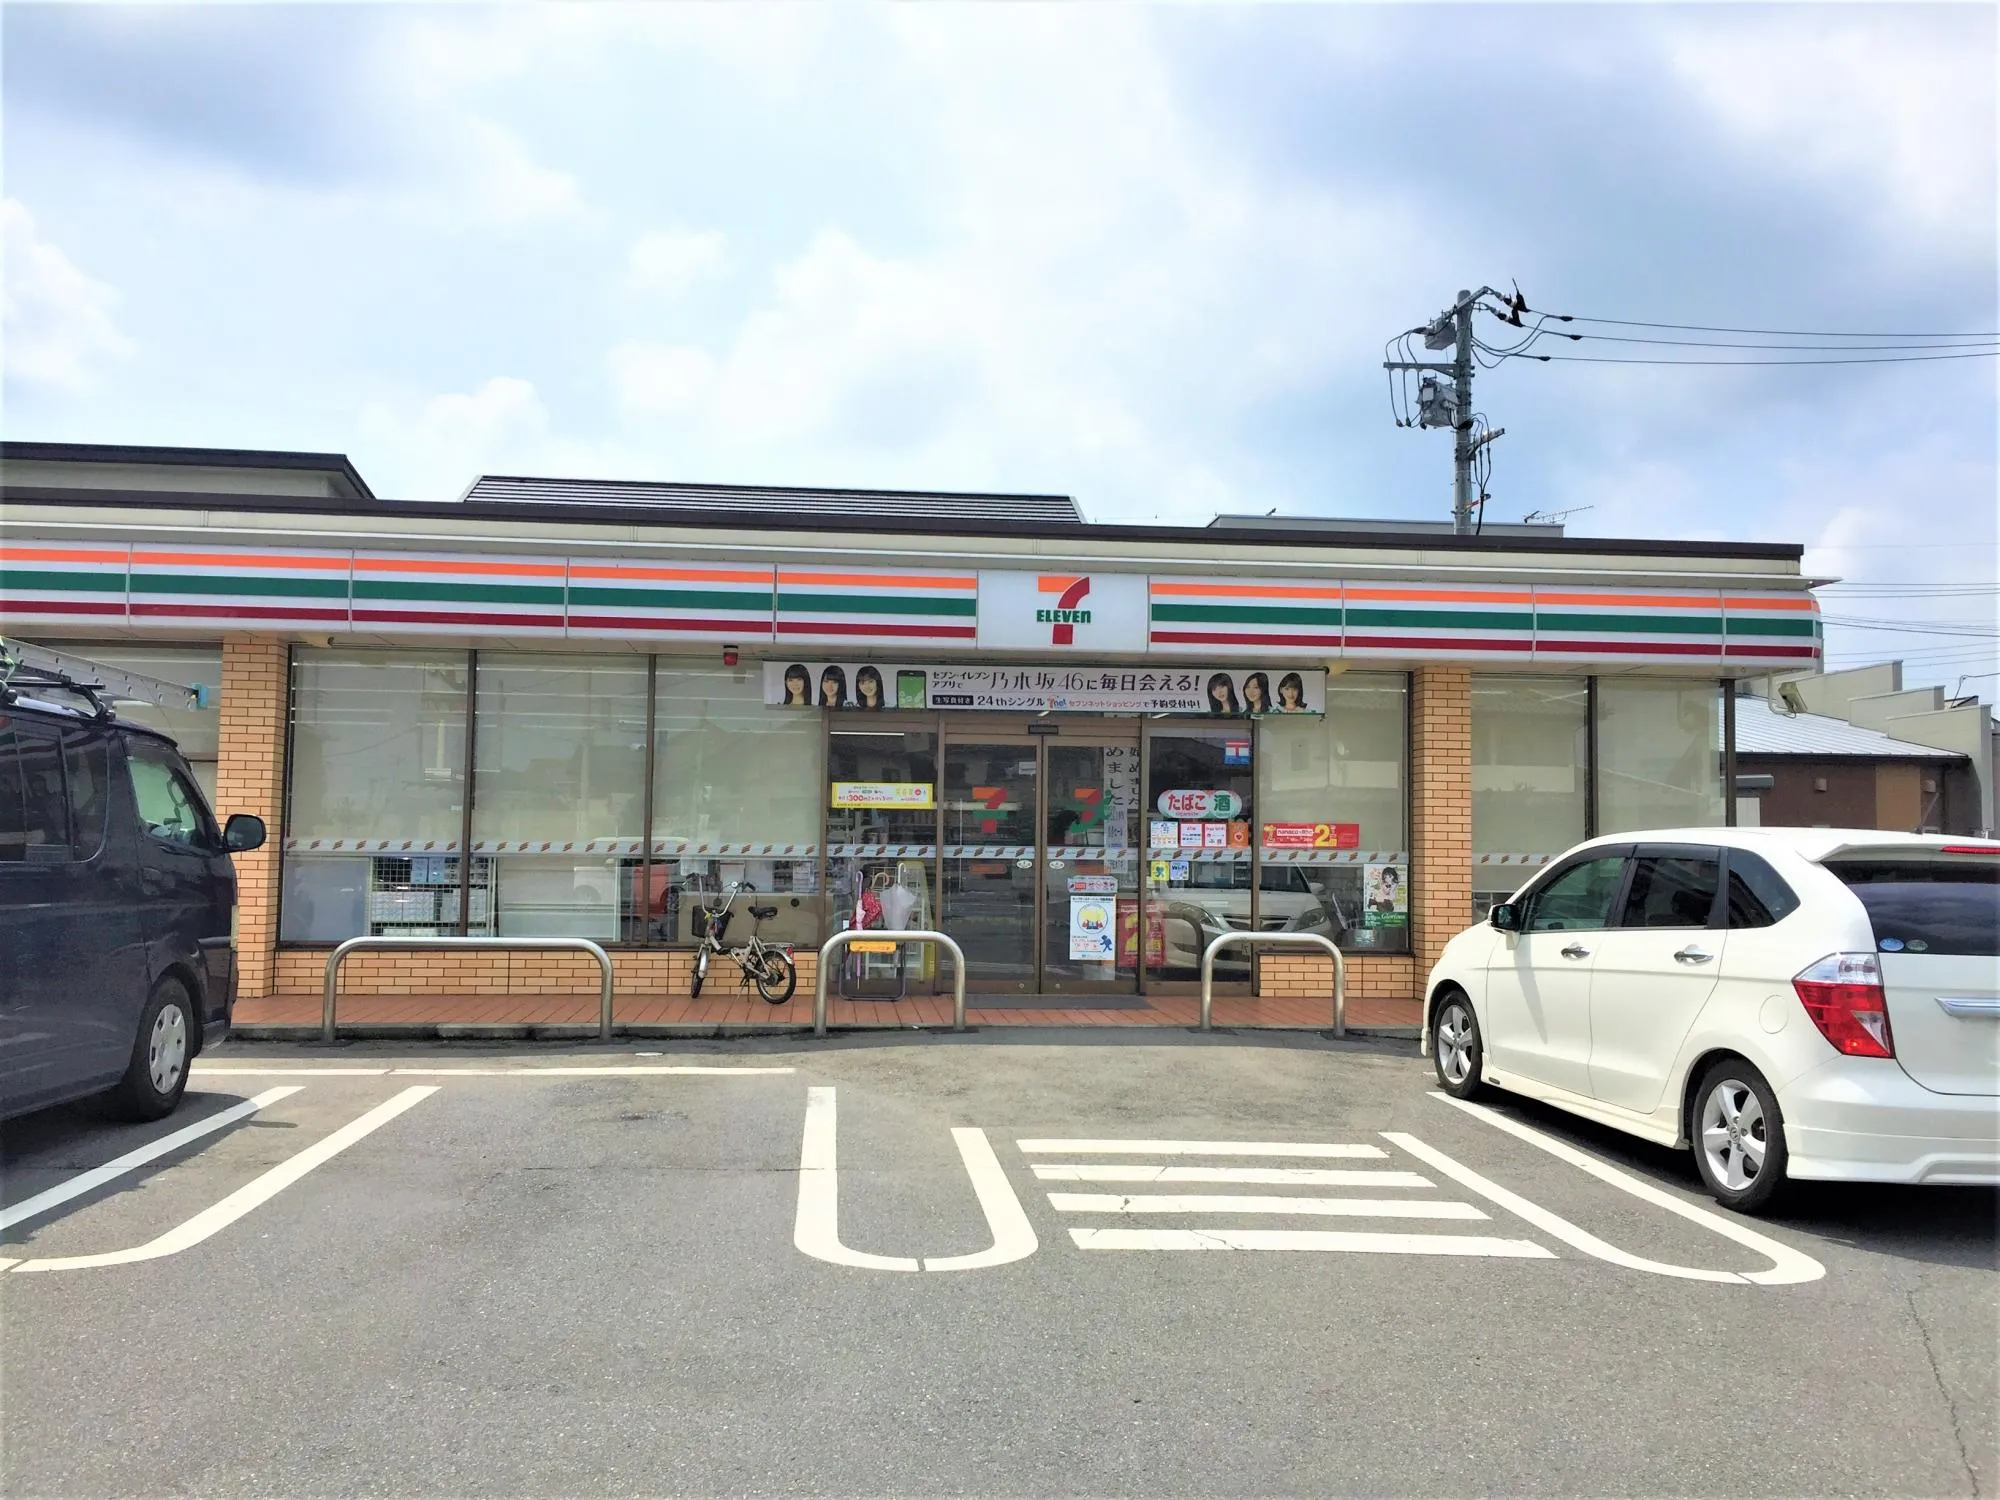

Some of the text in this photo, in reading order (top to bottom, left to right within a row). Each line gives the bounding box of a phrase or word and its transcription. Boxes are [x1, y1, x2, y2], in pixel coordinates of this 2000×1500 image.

[1037, 575, 1090, 646] 7
[1168, 794, 1231, 811] たばこ 酒
